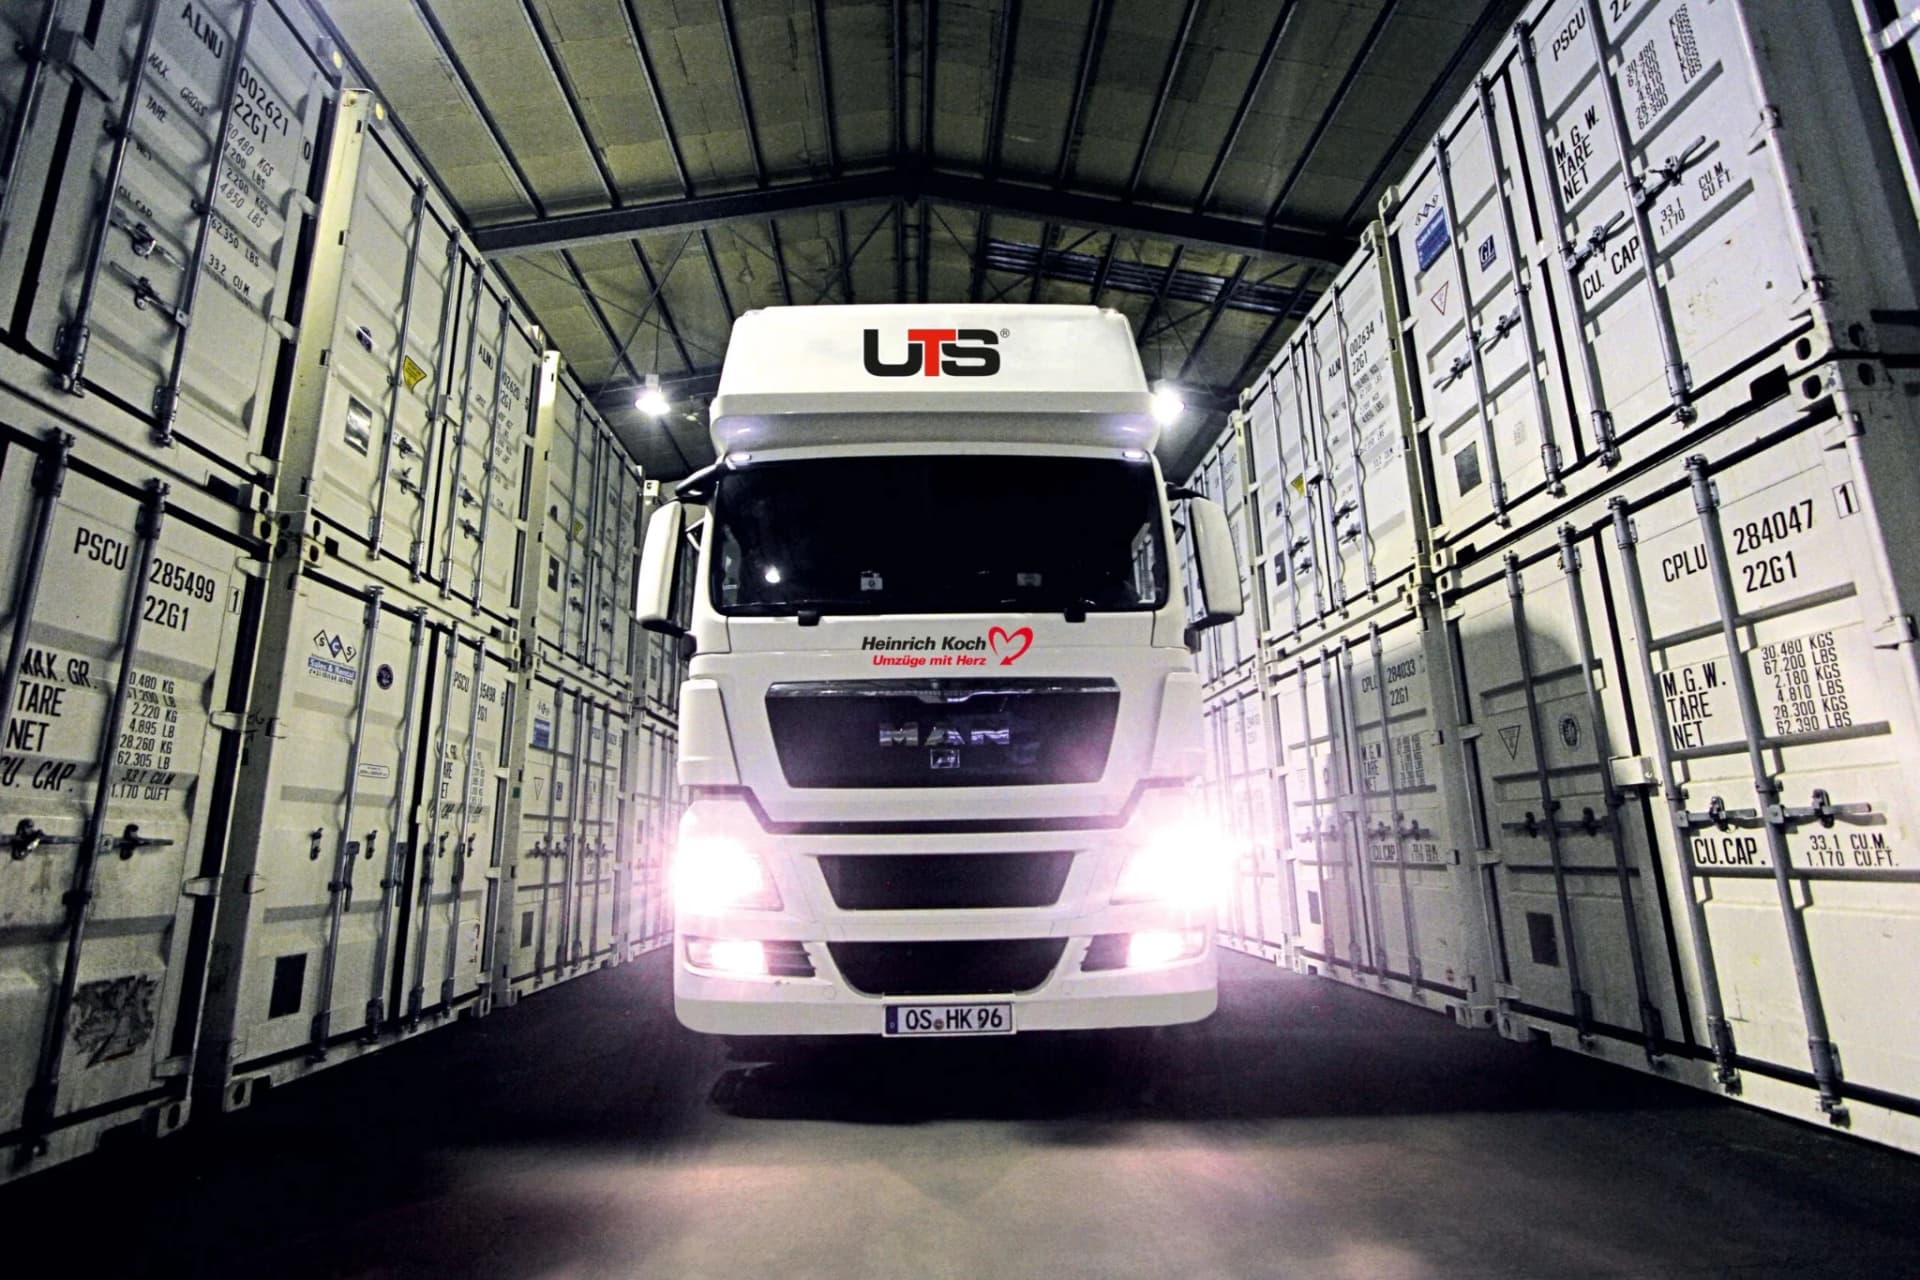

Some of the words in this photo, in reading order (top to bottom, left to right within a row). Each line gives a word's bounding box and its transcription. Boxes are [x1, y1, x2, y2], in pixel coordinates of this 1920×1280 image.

[1552, 8, 1586, 62] PSCU
[182, 2, 223, 58] ALNU
[240, 67, 288, 136] 002621
[304, 141, 312, 160] 0
[234, 94, 267, 143] 22G1
[1559, 134, 1594, 181] TARE
[1563, 162, 1588, 204] NET
[1328, 357, 1341, 379] ALN
[1662, 543, 1708, 583] CPLU
[1733, 498, 1813, 555] 284047
[1838, 484, 1853, 514] 1
[73, 526, 130, 571] PSCU
[149, 557, 216, 603] 285499
[232, 589, 240, 613] 1
[1742, 550, 1798, 593] 22G1
[143, 595, 189, 632] 22G1
[861, 636, 936, 651] Heinrich
[941, 636, 987, 651] Koch
[1761, 638, 1803, 661] 30.480
[1808, 631, 1834, 650] KGS
[67, 658, 98, 689] GR.
[872, 654, 926, 668] Umzüge
[929, 655, 953, 666] mit
[956, 655, 987, 666] Herz
[1763, 653, 1806, 675] 67.200
[1811, 647, 1838, 666] LBS
[162, 679, 175, 694] KG
[1774, 669, 1809, 689] 2.180
[1814, 662, 1841, 681] KGS
[17, 681, 66, 717] TARE
[1777, 684, 1812, 703] 4.810
[1818, 678, 1844, 697] LBS
[165, 709, 178, 724] KG
[1668, 691, 1713, 723] TARE
[1773, 699, 1816, 720] 28.300
[1821, 695, 1848, 713] KGS
[1825, 711, 1852, 729] LBS
[5, 717, 50, 752] NET
[129, 718, 157, 735] 4.895
[162, 723, 175, 738] LB
[879, 727, 1010, 746] MAN
[1672, 720, 1706, 750] NET
[119, 733, 155, 752] 28.260
[160, 740, 173, 754] KG
[117, 750, 152, 768] 62.305
[157, 755, 171, 770] LB
[111, 783, 139, 799] 1.170
[1809, 833, 1840, 851] 33.1
[1850, 833, 1890, 850] CU.M.
[1806, 851, 1845, 867] 1.170
[1854, 850, 1899, 867] CU.FT.
[905, 1009, 932, 1030] OS
[946, 1008, 972, 1029] HK
[977, 1008, 1003, 1028] 96
